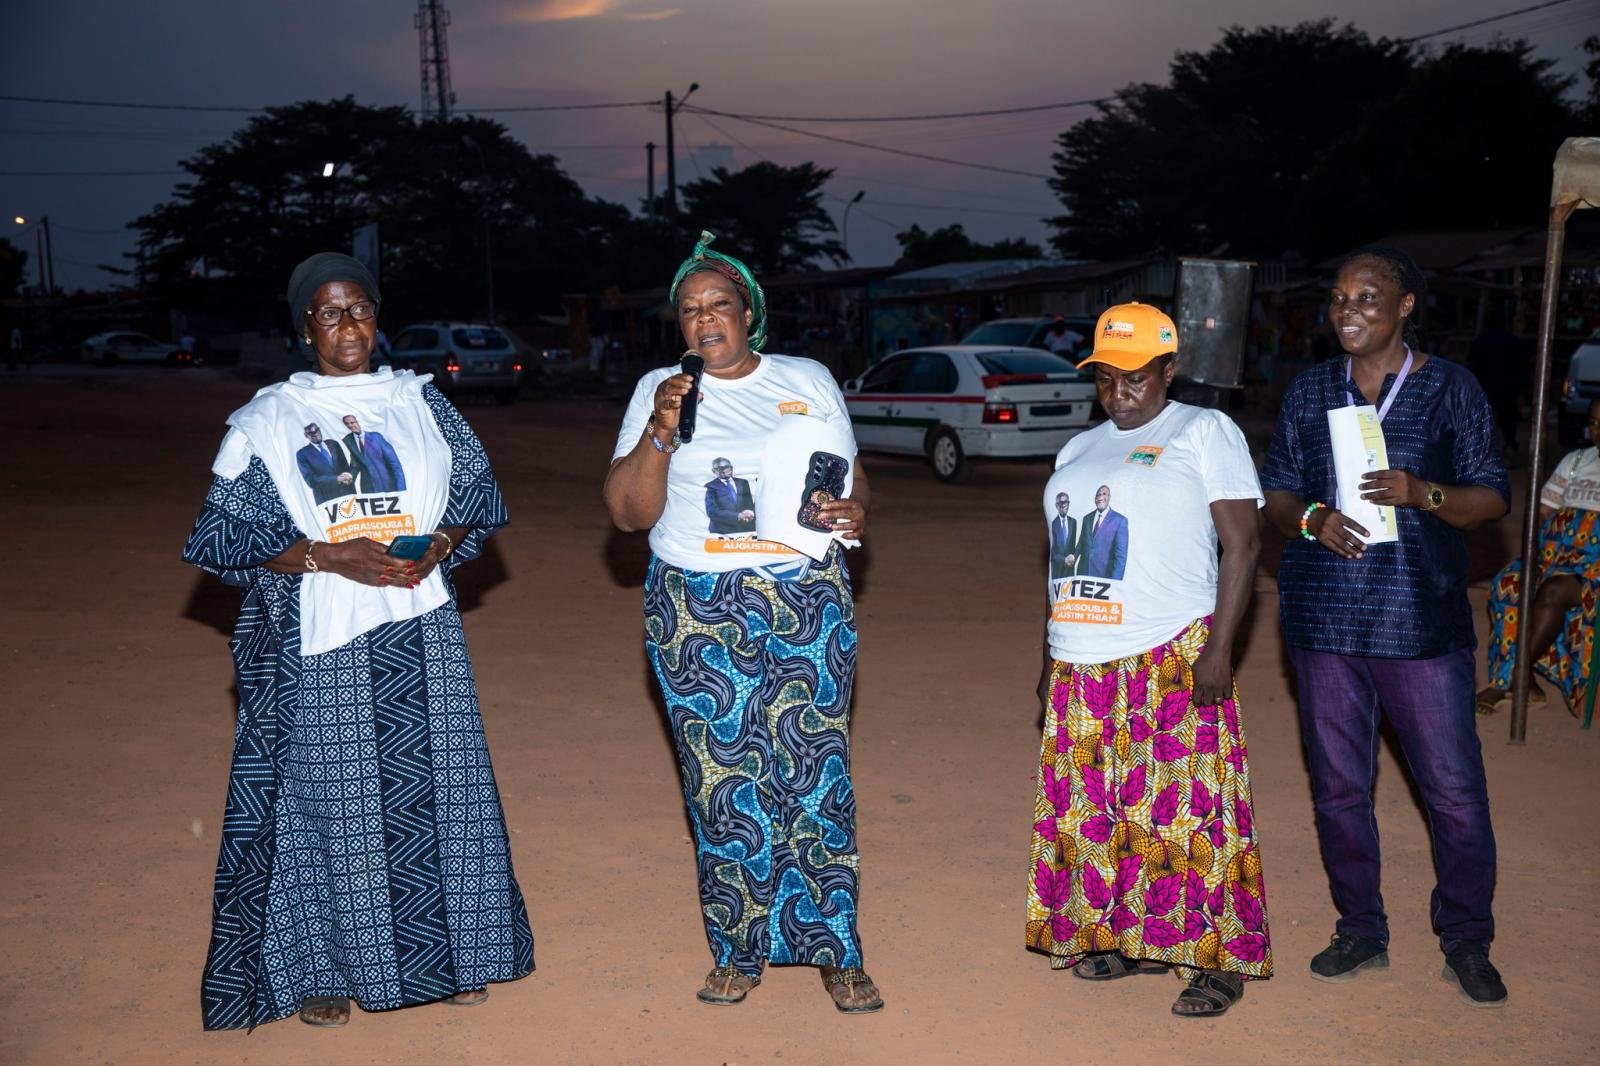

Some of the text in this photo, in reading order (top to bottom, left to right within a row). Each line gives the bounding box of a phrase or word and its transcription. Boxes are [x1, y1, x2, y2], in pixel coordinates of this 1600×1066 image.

[324, 495, 401, 524] VOTEZ
[722, 541, 777, 551] AUGUSTIN
[1053, 579, 1112, 600] VOTEZ
[1110, 604, 1120, 615] &
[1086, 613, 1118, 623] THIAM
